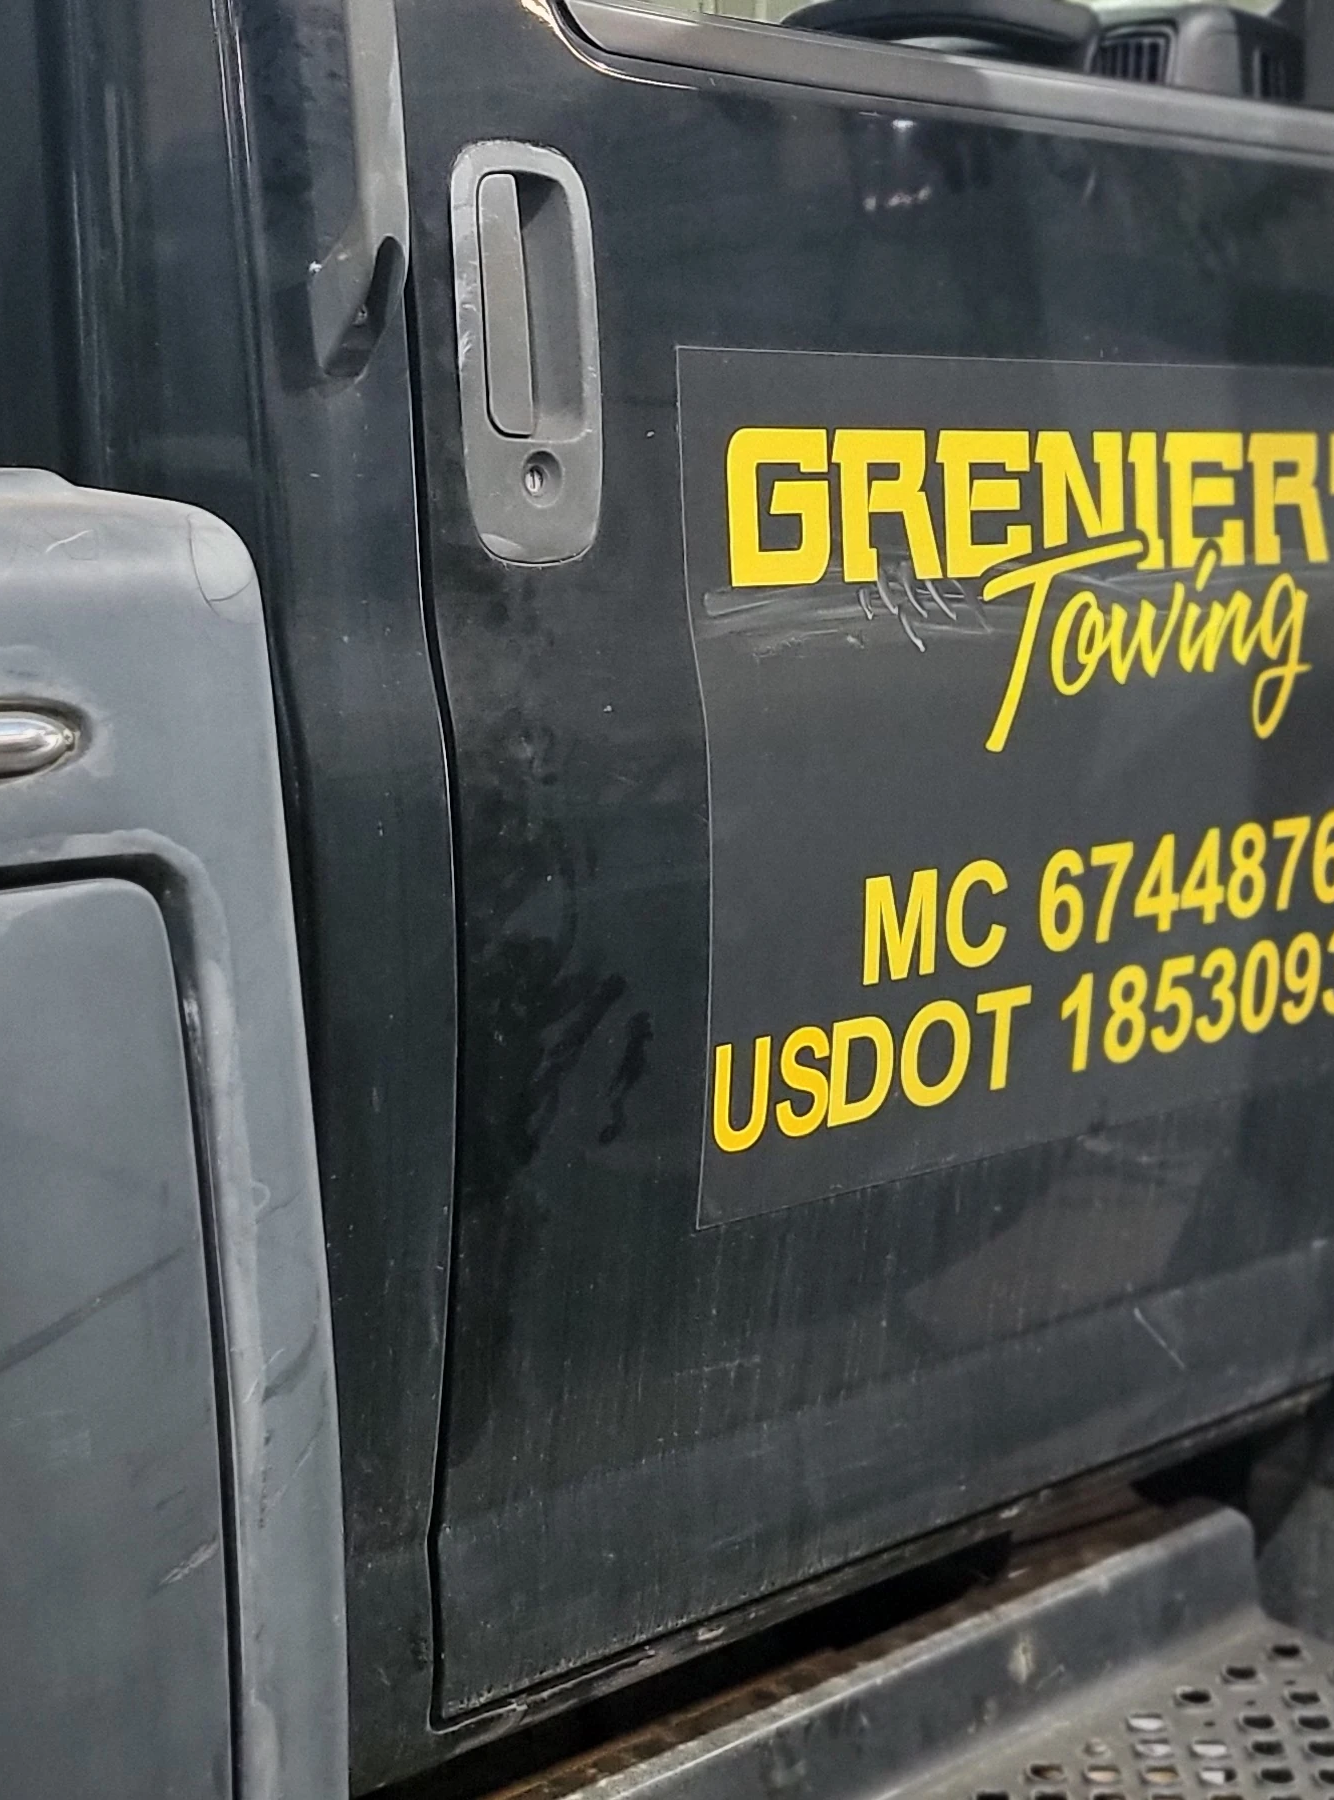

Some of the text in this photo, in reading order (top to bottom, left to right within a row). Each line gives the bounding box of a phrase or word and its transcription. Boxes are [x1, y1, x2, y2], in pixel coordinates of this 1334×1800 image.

[983, 540, 1311, 753] Towing
[862, 859, 1009, 986] MC
[712, 984, 1033, 1153] USDOT
